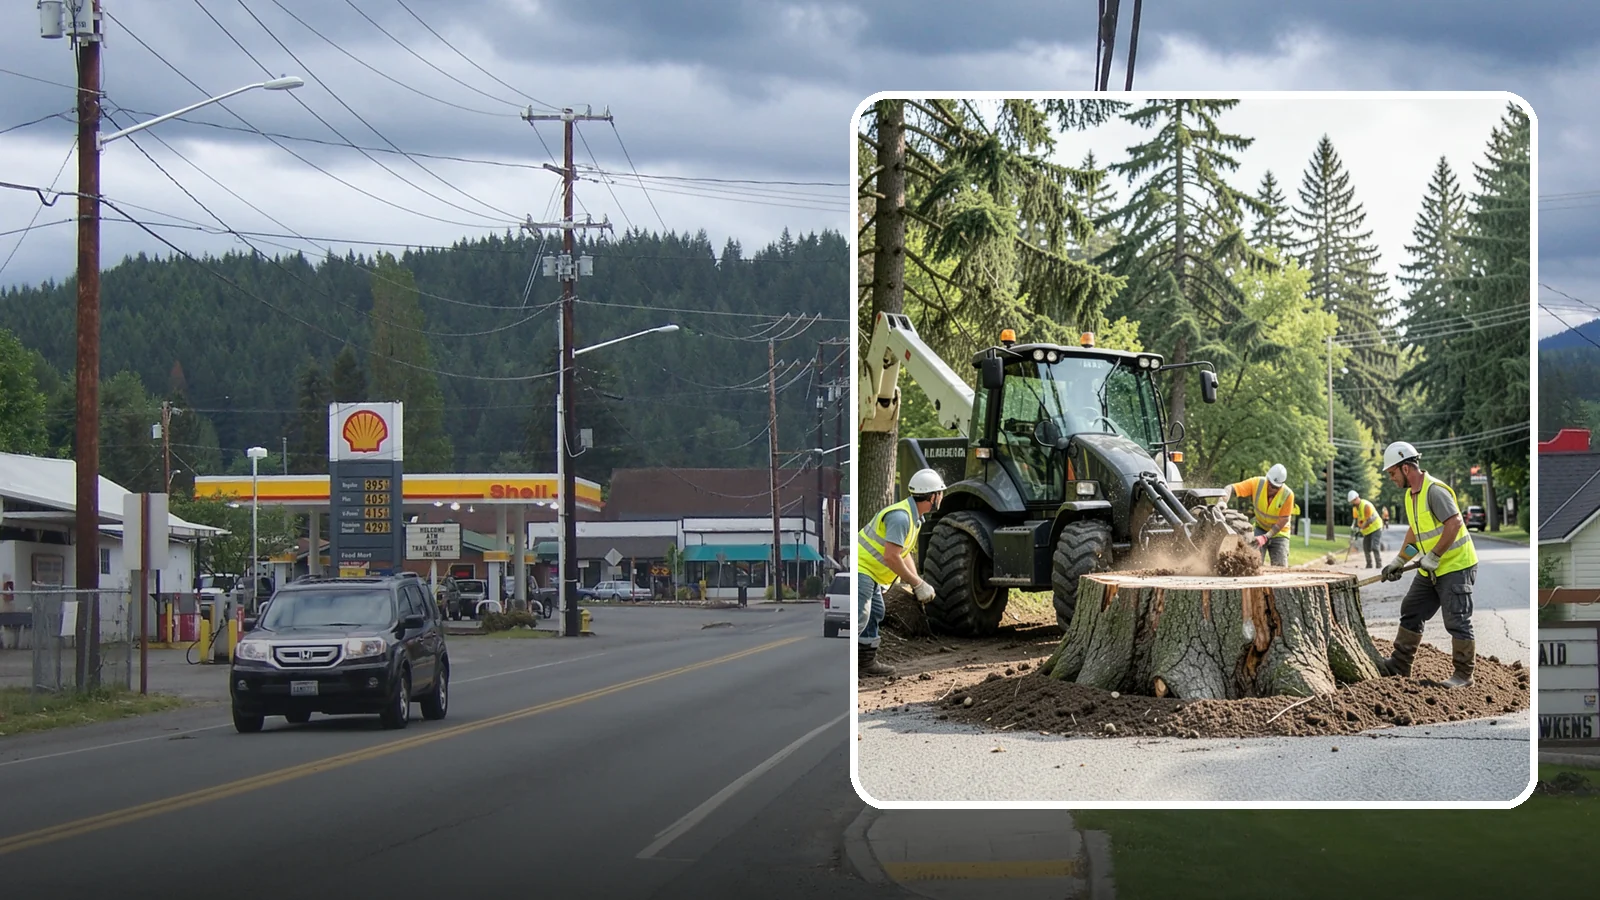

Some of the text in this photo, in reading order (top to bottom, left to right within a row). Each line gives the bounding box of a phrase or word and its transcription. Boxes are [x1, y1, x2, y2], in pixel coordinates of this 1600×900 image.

[366, 480, 383, 490] 395
[490, 484, 547, 499] Shell
[366, 494, 383, 504] 405
[366, 508, 383, 518] 415
[366, 522, 383, 532] 429
[1538, 642, 1566, 666] AID
